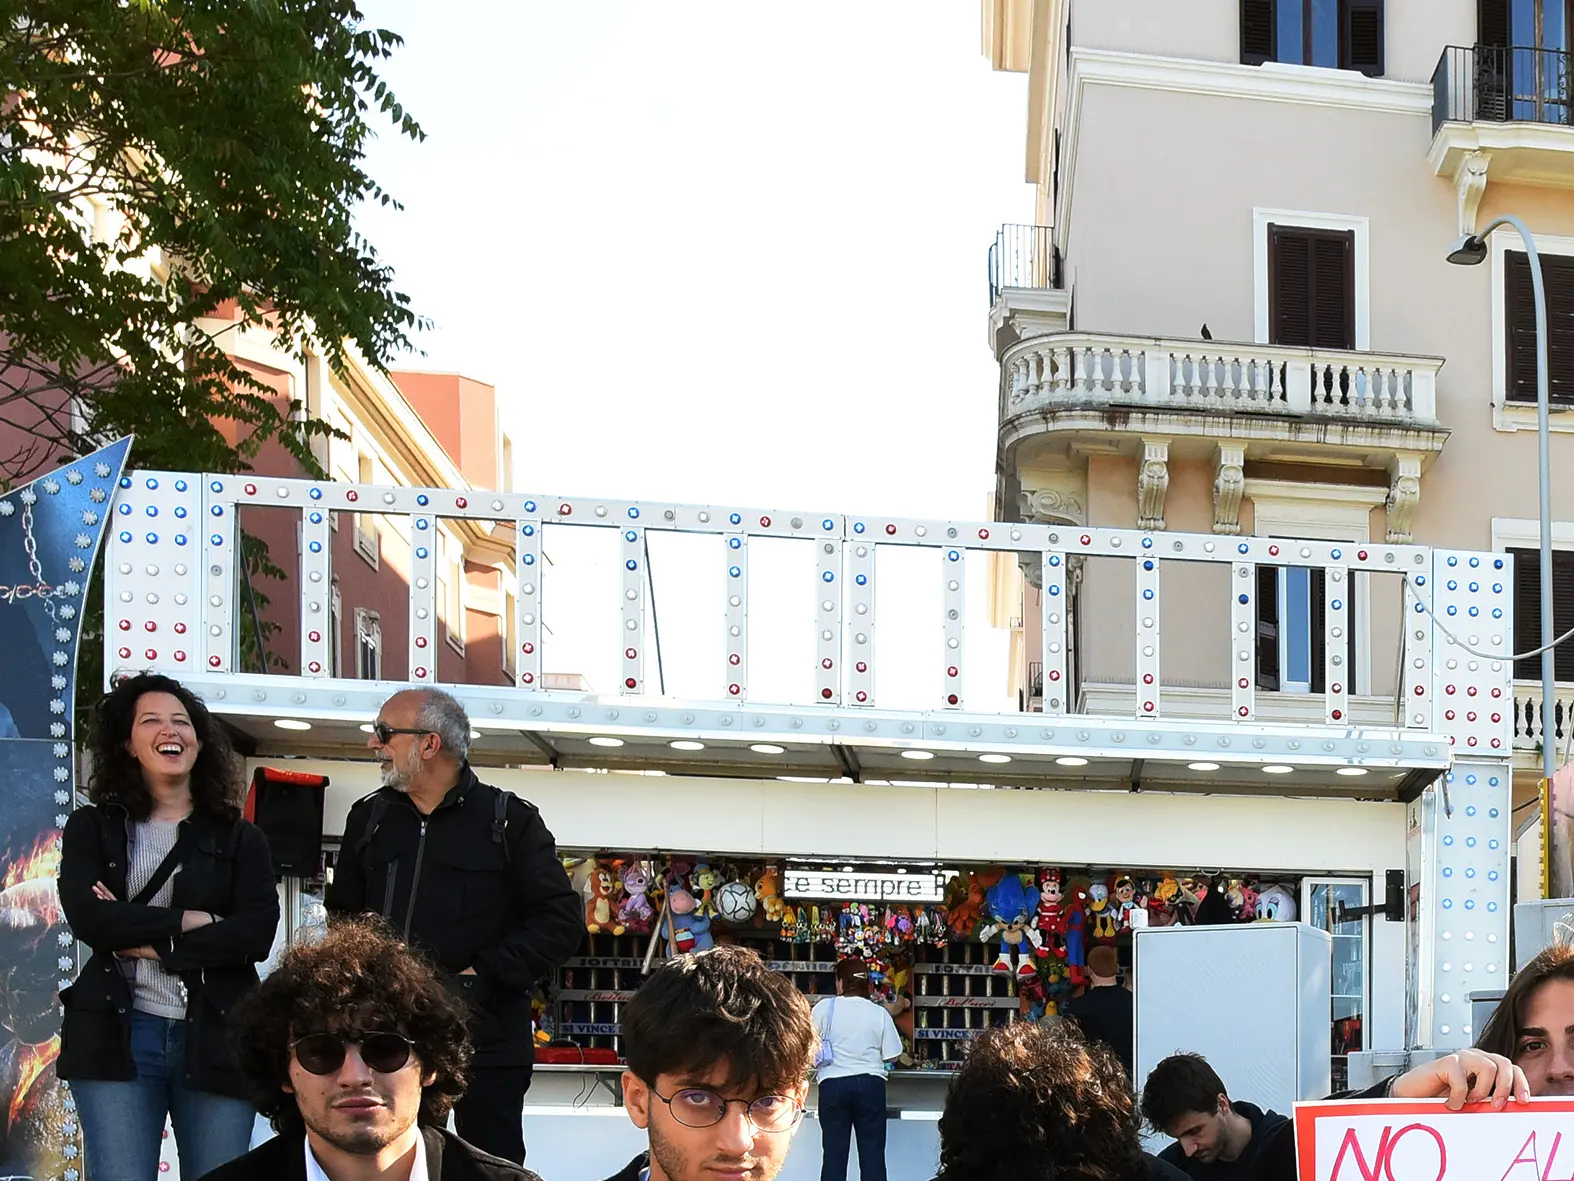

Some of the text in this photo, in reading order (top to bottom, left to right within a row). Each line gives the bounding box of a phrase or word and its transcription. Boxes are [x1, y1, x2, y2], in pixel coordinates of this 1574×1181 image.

[822, 878, 921, 899] sempre
[577, 1024, 616, 1034] VINCE
[933, 1029, 970, 1039] VINCE
